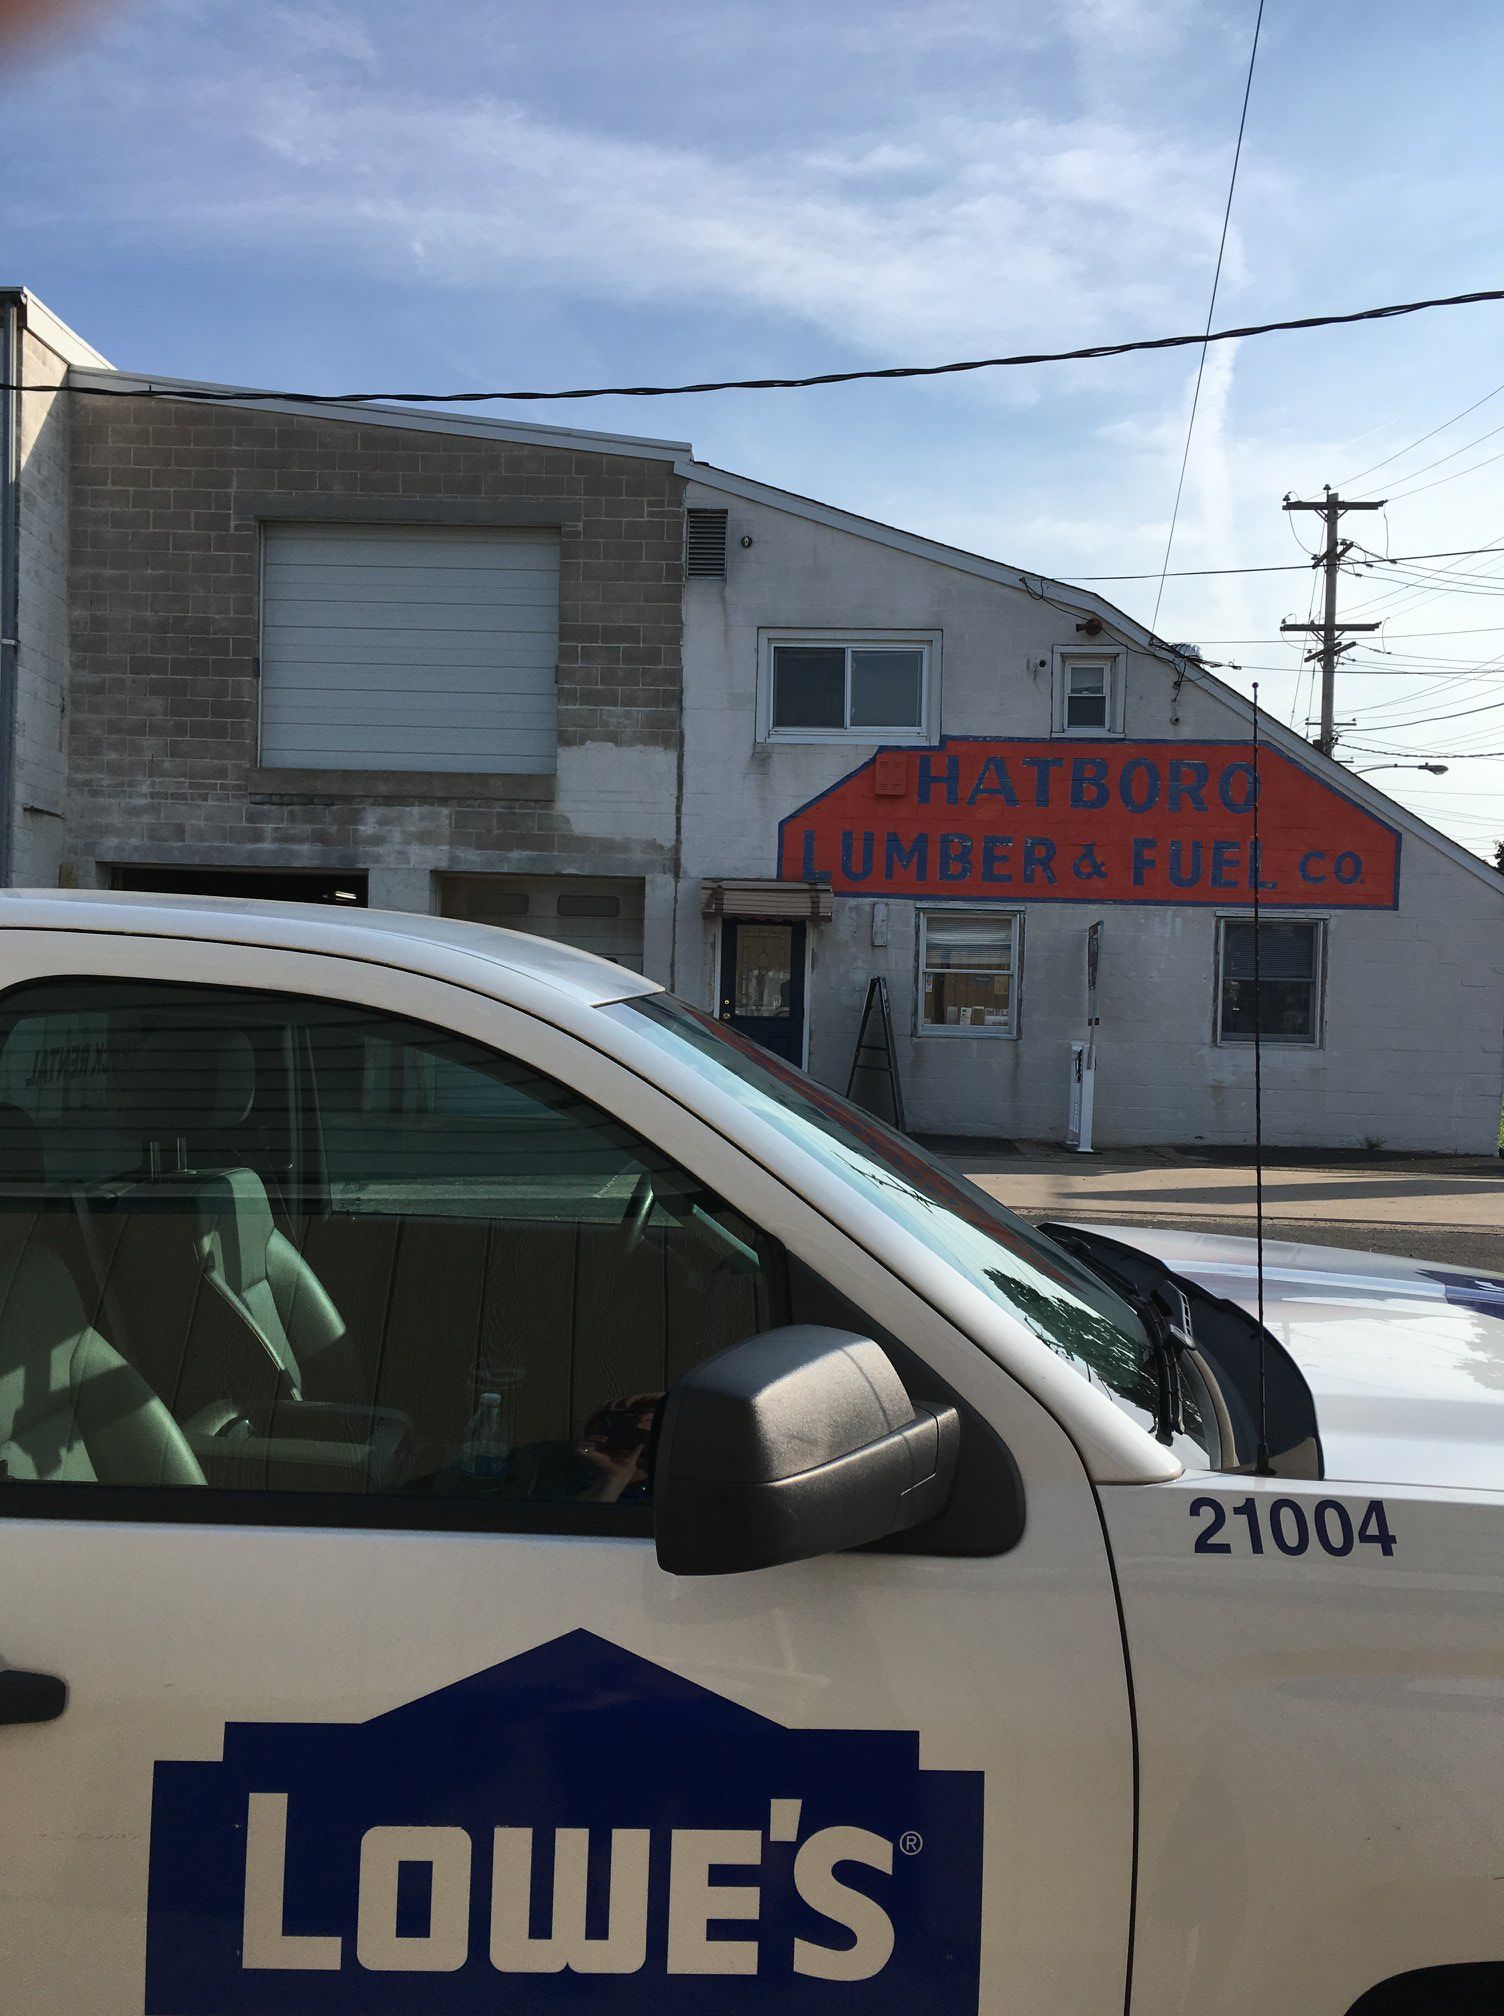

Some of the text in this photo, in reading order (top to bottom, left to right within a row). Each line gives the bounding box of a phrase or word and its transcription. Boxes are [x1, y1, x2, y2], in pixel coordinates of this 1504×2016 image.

[917, 755, 1262, 813] HATBORO
[803, 830, 1058, 884] LUMBER
[1072, 842, 1109, 880] &
[1132, 838, 1277, 890] FUEL
[1189, 1497, 1398, 1557] 21004
[242, 1793, 895, 1982] LOWE'S
